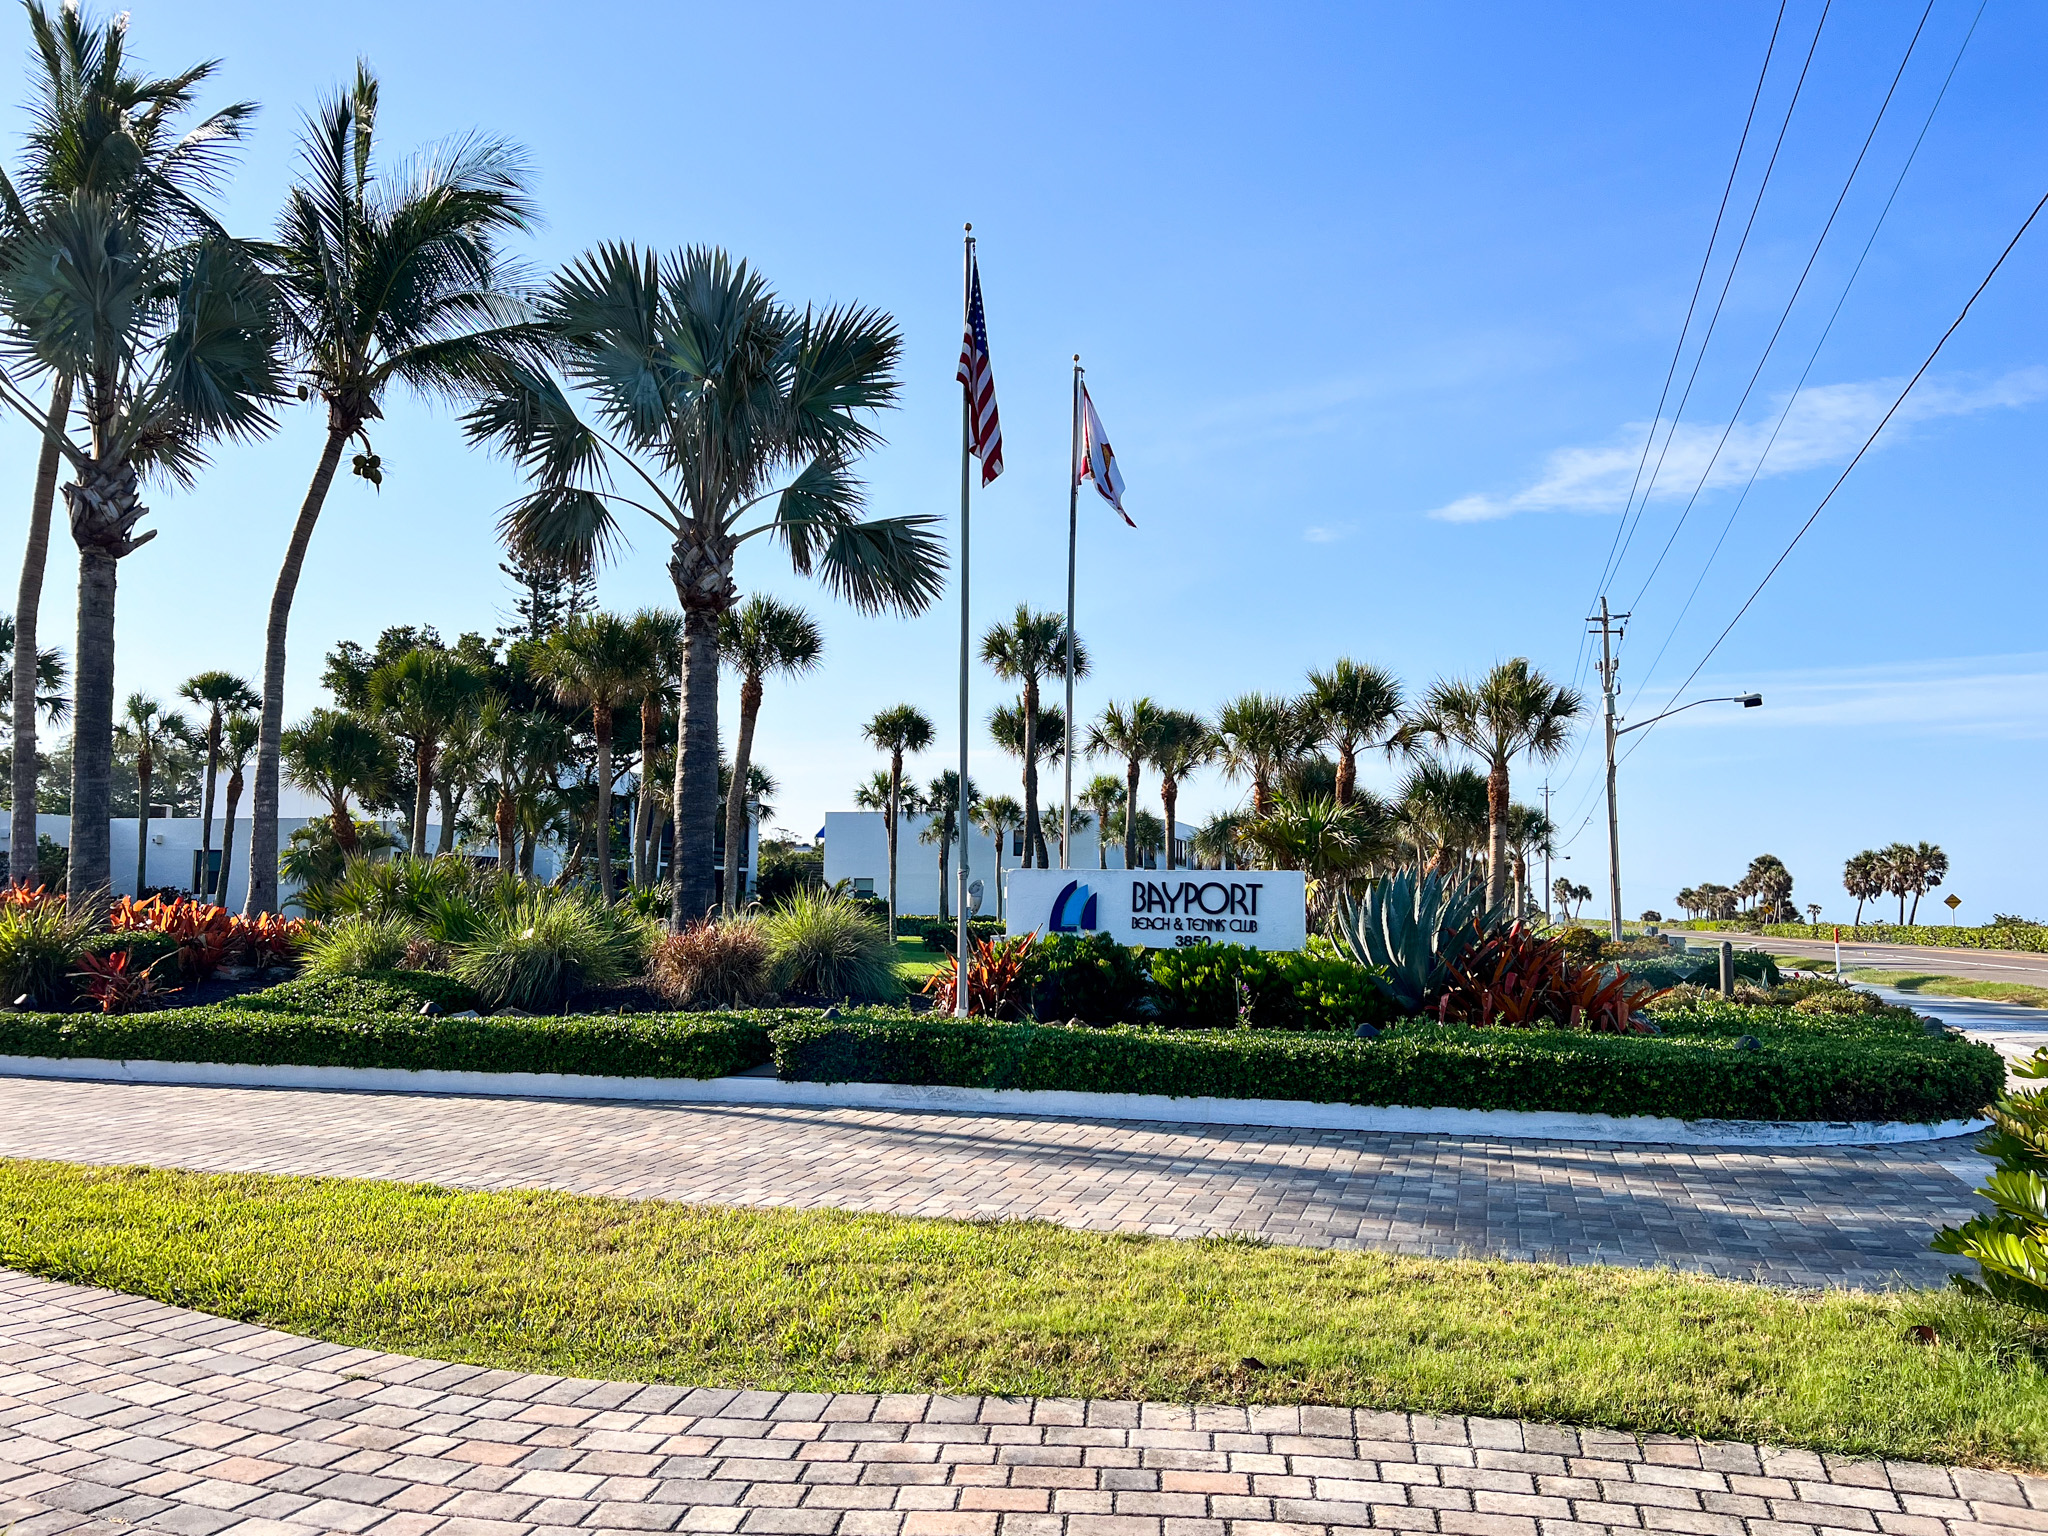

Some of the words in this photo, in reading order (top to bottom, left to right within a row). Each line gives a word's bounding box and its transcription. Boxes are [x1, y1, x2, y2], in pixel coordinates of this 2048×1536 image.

[1132, 881, 1263, 915] BAYPORT
[1131, 916, 1170, 931] BEACH
[1173, 917, 1184, 931] &
[1185, 917, 1227, 932] TENNIS
[1229, 918, 1258, 933] CLUB
